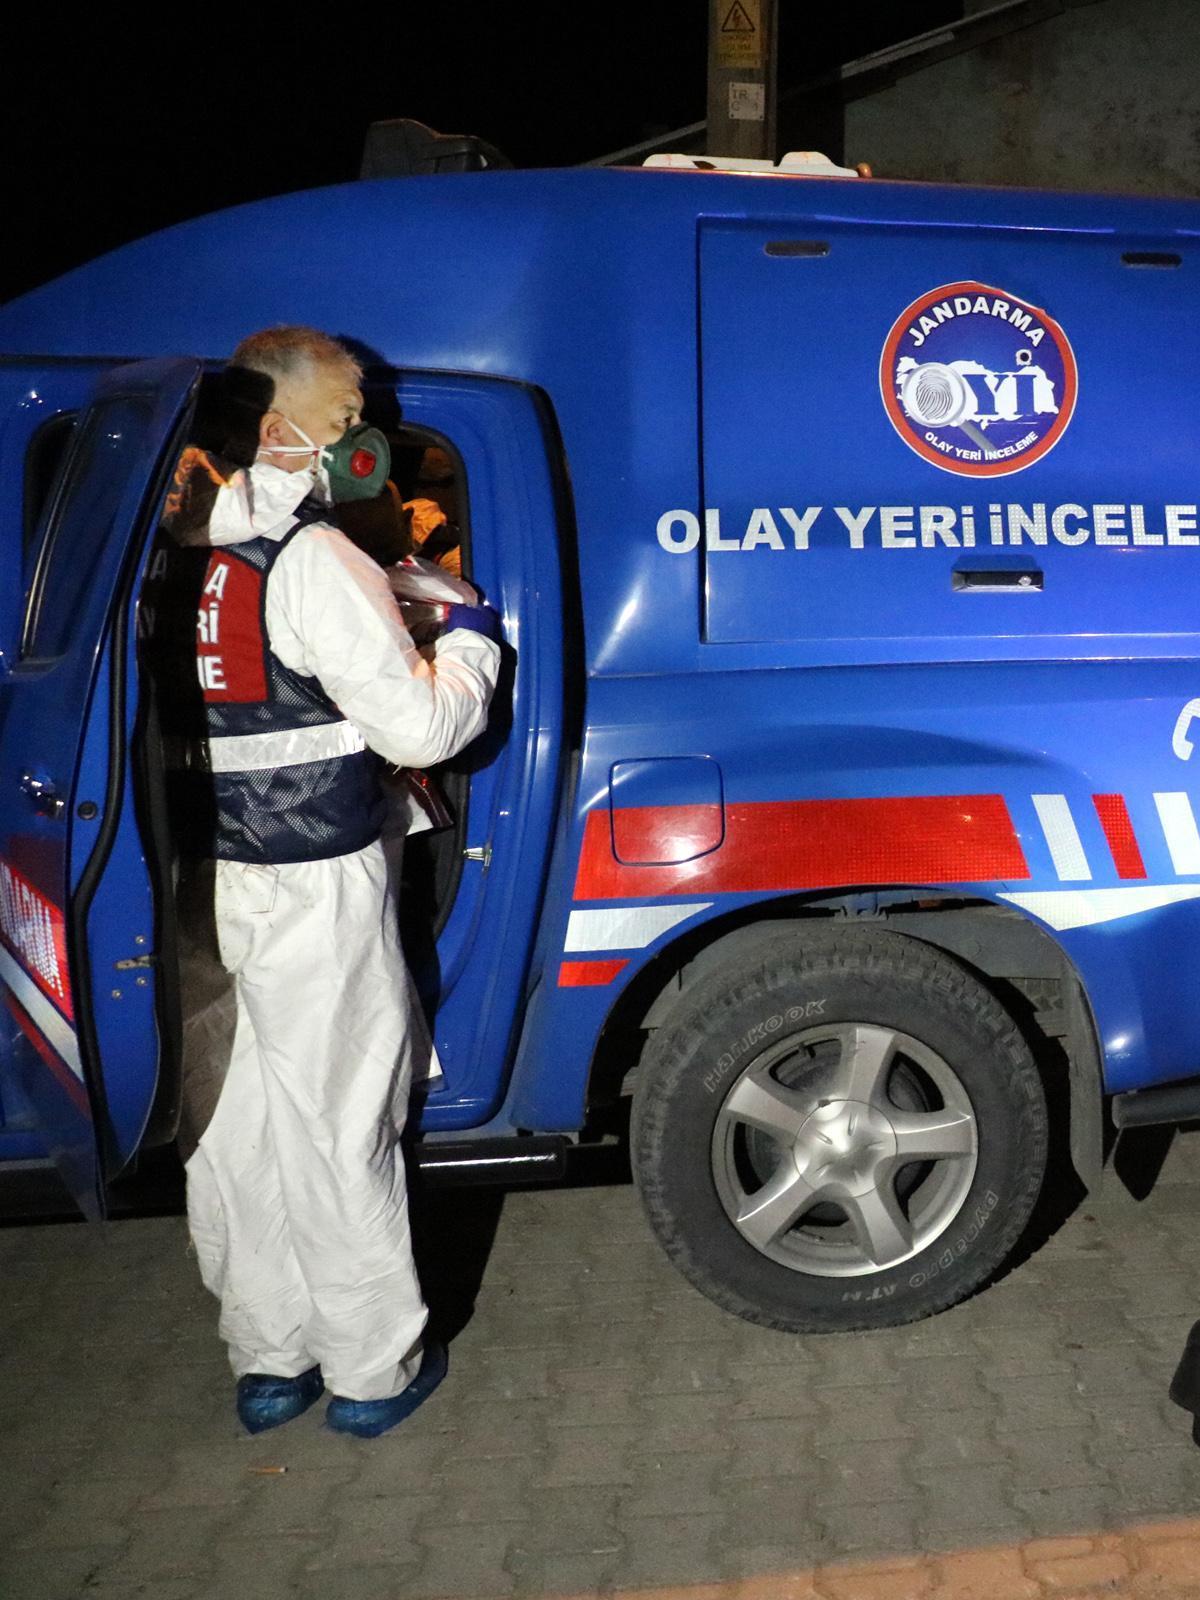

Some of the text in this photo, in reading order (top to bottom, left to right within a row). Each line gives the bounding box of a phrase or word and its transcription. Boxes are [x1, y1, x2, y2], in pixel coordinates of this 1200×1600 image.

[908, 296, 1046, 347] JANDARMA
[925, 431, 954, 454] OLAY
[656, 506, 823, 554] OLAY
